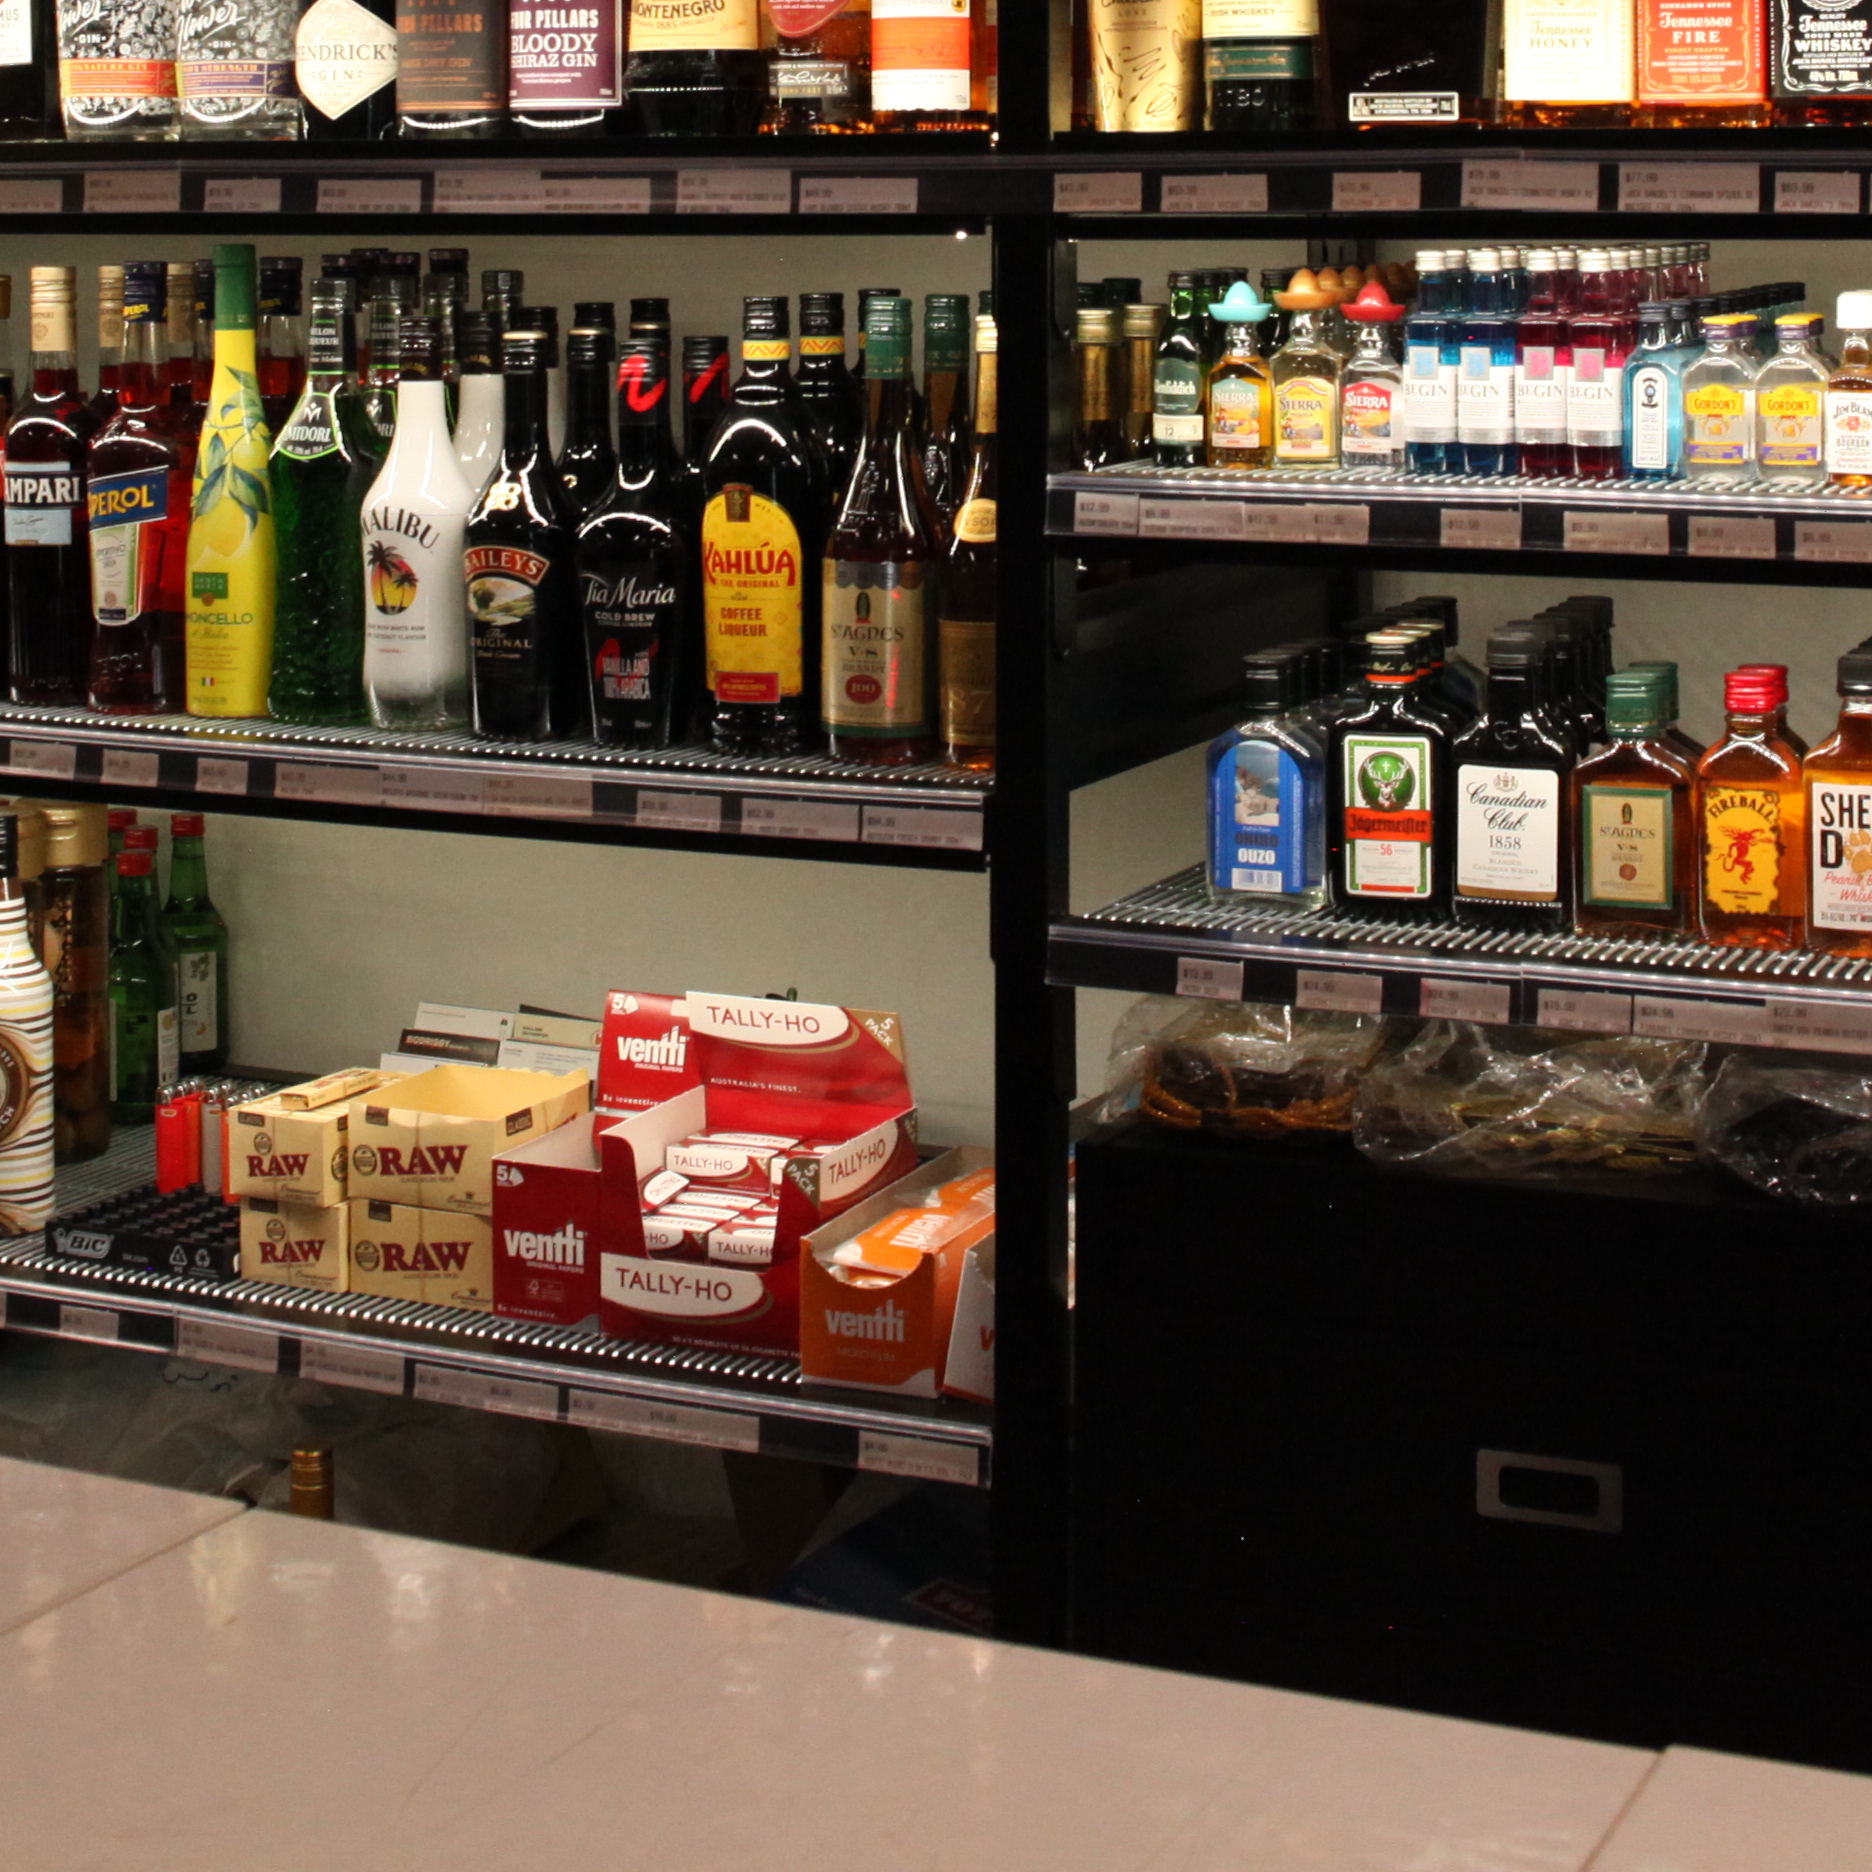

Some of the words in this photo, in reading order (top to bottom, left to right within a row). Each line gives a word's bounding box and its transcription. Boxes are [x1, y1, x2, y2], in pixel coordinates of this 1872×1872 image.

[534, 8, 599, 30] PILLARS
[510, 32, 598, 54] BLOODY
[564, 52, 598, 68] GIN
[1344, 394, 1389, 409] SIERRA
[614, 576, 676, 609] Maria
[720, 606, 763, 621] COFFEE
[718, 622, 767, 637] LIQUEUR
[1465, 782, 1548, 810] Canadian
[1708, 794, 1777, 827] FIREBALL
[1488, 836, 1522, 851] 1858
[1237, 848, 1276, 865] OUZO
[706, 1006, 821, 1034] TALLY-HO
[864, 1017, 894, 1046] PACK
[246, 1153, 310, 1177] RAW
[377, 1144, 469, 1176] RAW
[672, 1154, 733, 1171] TALLY-HO
[828, 1137, 887, 1181] TALLY-HO
[260, 1239, 326, 1264] RAW
[381, 1241, 473, 1272] RAW
[615, 1267, 733, 1302] TALLY-HO
